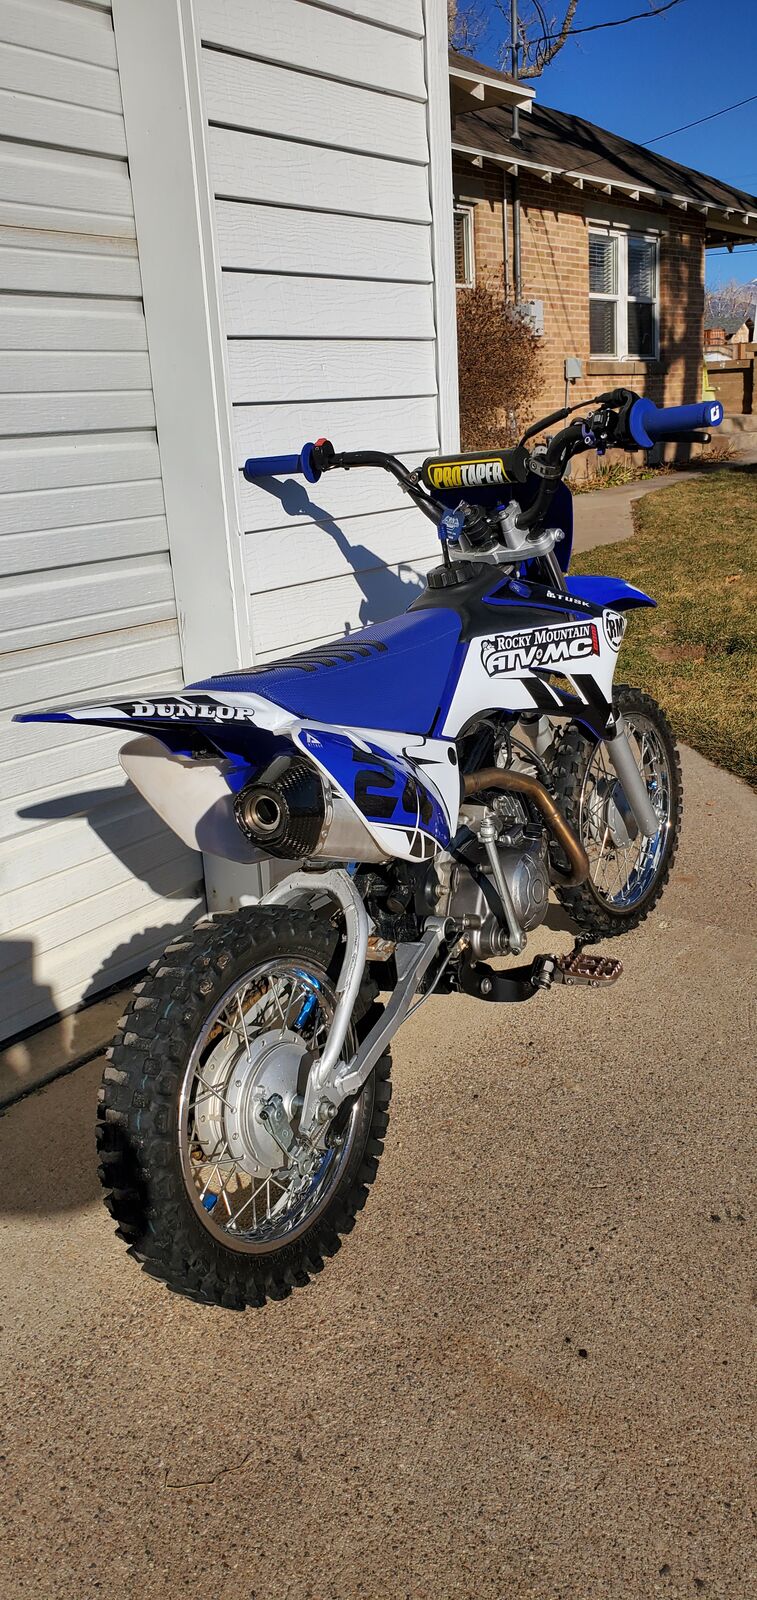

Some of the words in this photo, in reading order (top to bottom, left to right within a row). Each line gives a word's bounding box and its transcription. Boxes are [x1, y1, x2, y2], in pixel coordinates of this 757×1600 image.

[433, 462, 504, 488] PROTAPER
[556, 593, 591, 607] TUSK
[497, 635, 531, 650] ROCKY
[534, 625, 590, 644] MOUNTAIN
[132, 703, 254, 720] DUNLOP
